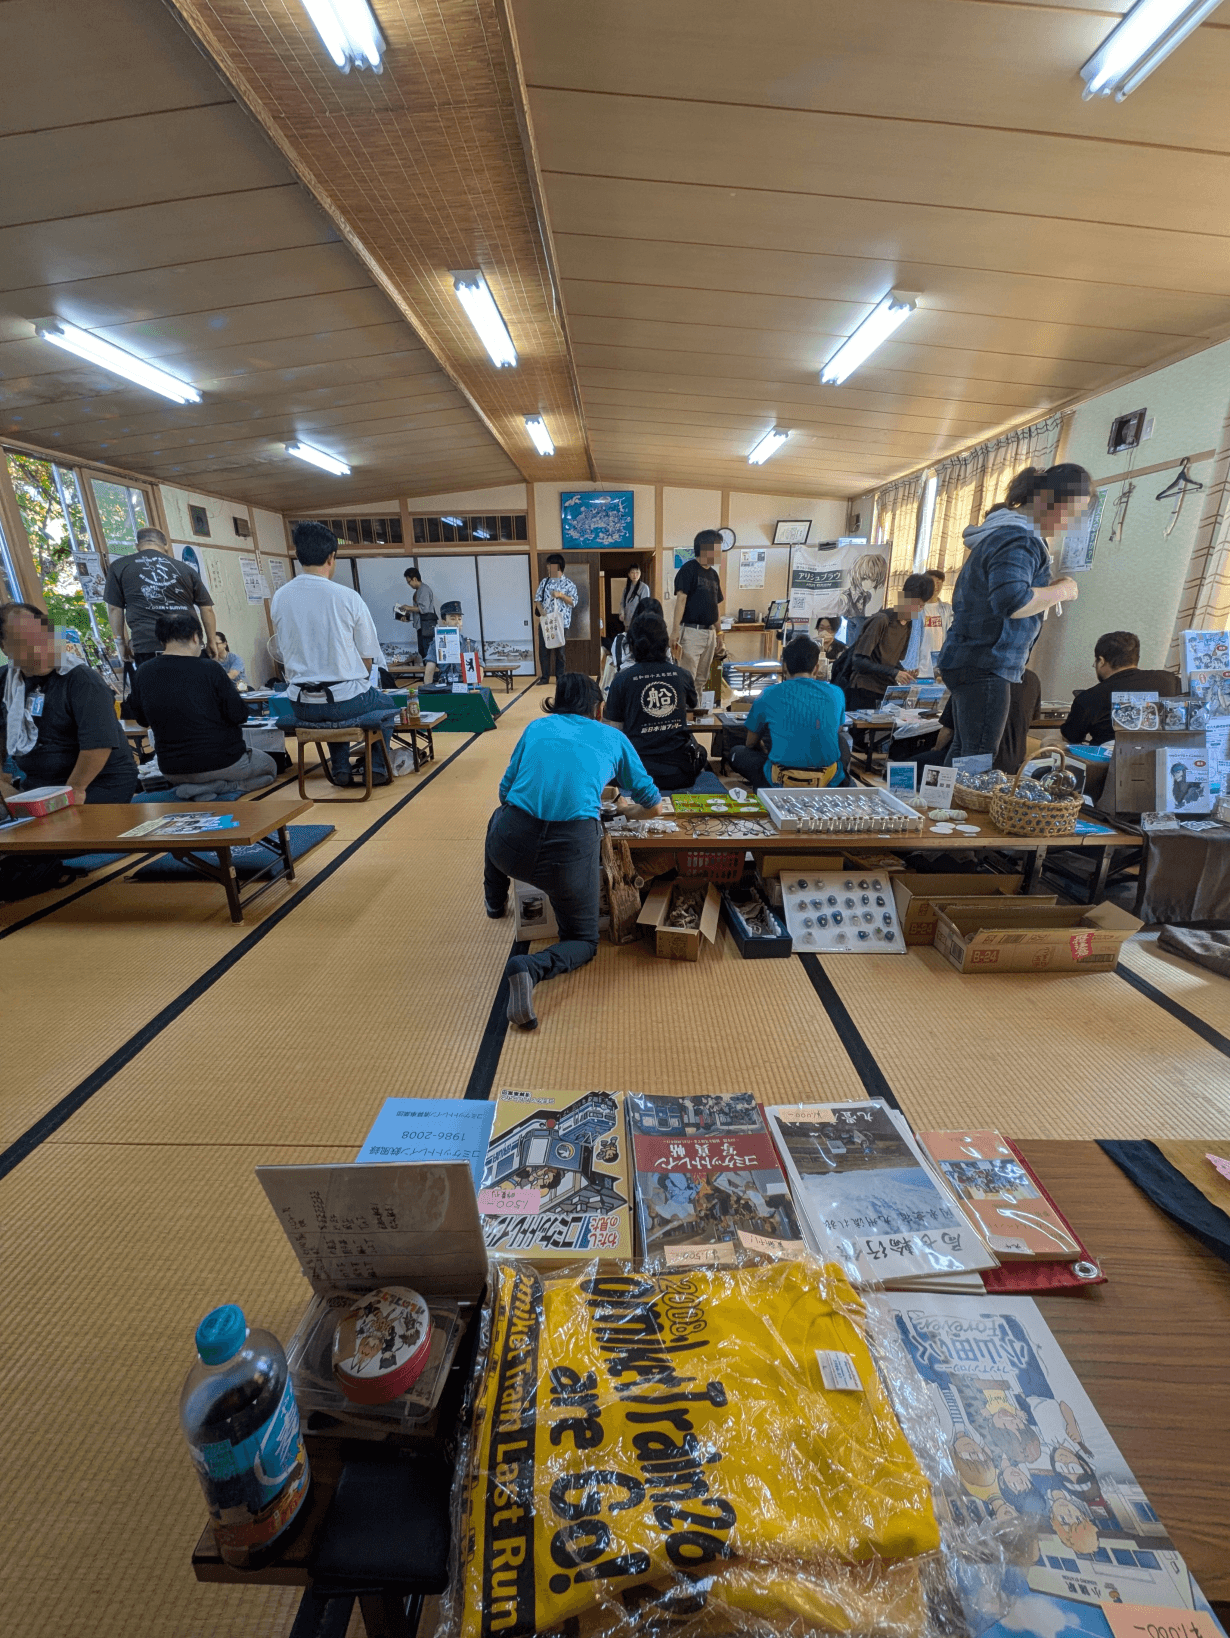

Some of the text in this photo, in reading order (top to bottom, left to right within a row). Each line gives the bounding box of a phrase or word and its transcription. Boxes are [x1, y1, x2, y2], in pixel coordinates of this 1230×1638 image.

[798, 572, 841, 581] アリシュブラウ
[646, 687, 673, 709] 船
[641, 722, 683, 734] 新日本海フェリー
[972, 950, 998, 963] B-24
[401, 1130, 466, 1142] 1986-2008
[654, 1155, 759, 1169] コミケットトレイン
[591, 1216, 619, 1232] の見た
[589, 1232, 618, 1248] わたし
[658, 1278, 707, 1336] 2008
[916, 1318, 999, 1337] Forever
[910, 1334, 1027, 1366] 小山田いく
[497, 1358, 532, 1434] Train
[549, 1366, 604, 1450] are
[490, 1441, 531, 1528] Last
[548, 1470, 651, 1595] Go!
[489, 1537, 526, 1631] Run
